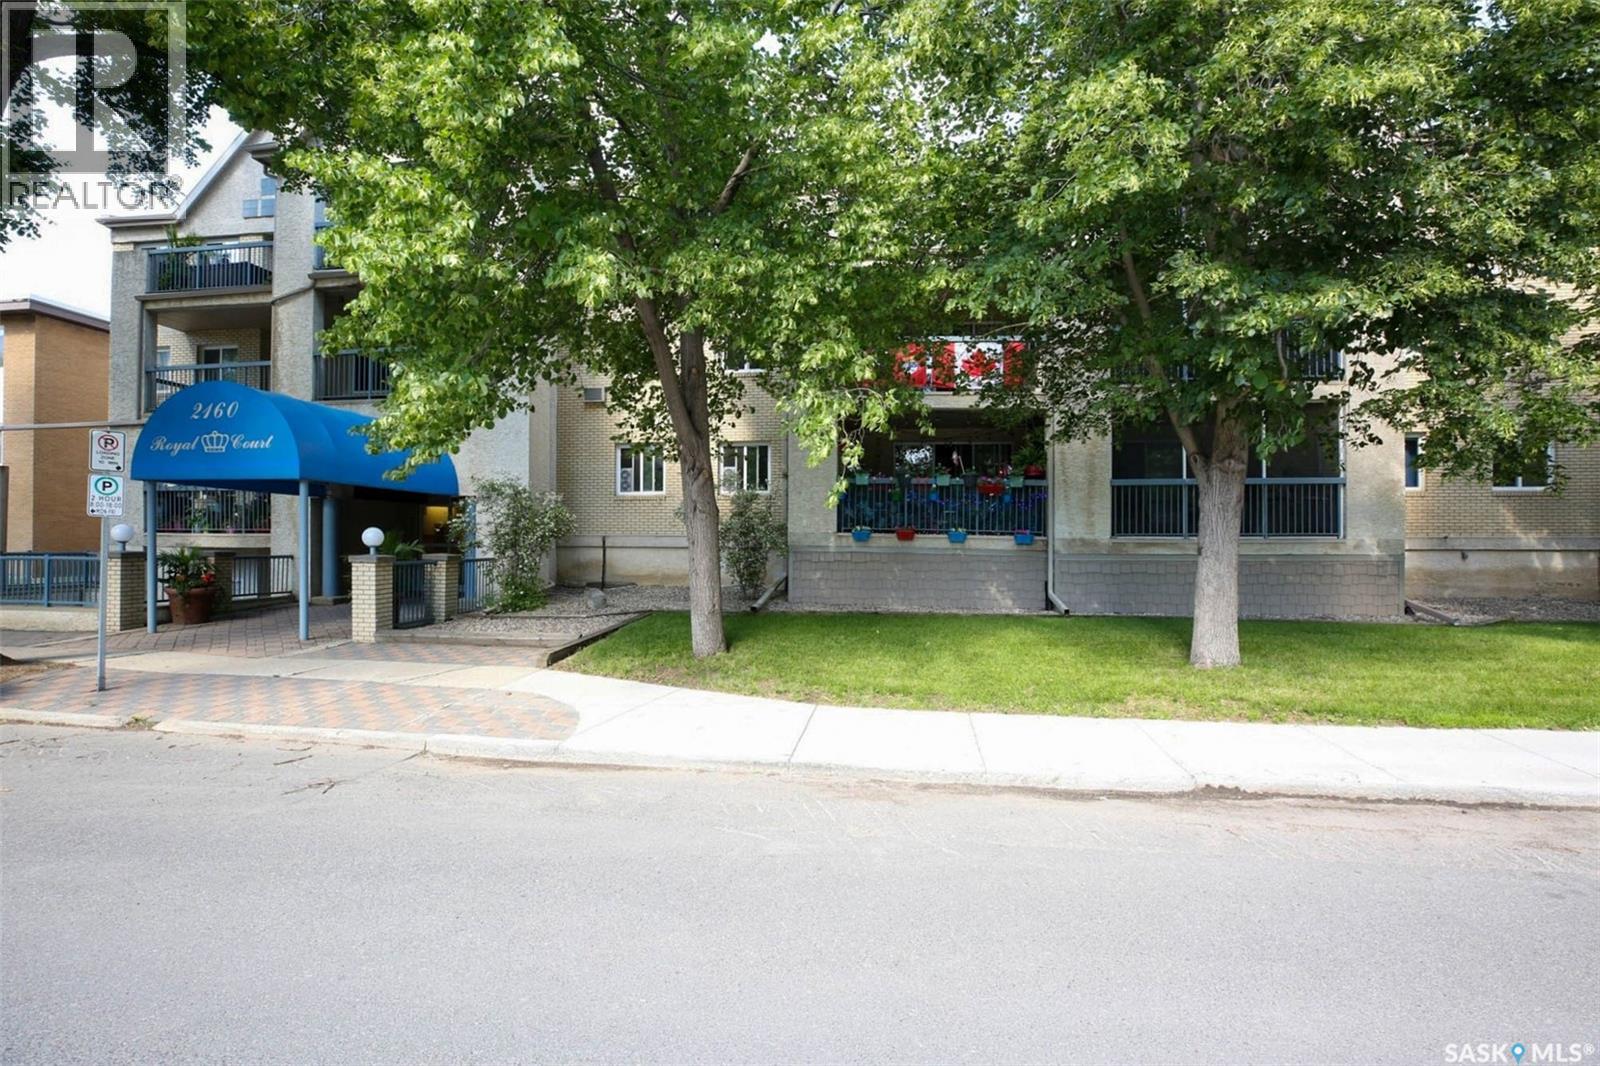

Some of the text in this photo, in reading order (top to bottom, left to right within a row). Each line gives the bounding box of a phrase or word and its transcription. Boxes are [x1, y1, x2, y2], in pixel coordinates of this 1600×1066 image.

[191, 401, 239, 419] 2160
[150, 433, 274, 456] Royal Court
[102, 481, 112, 491] P
